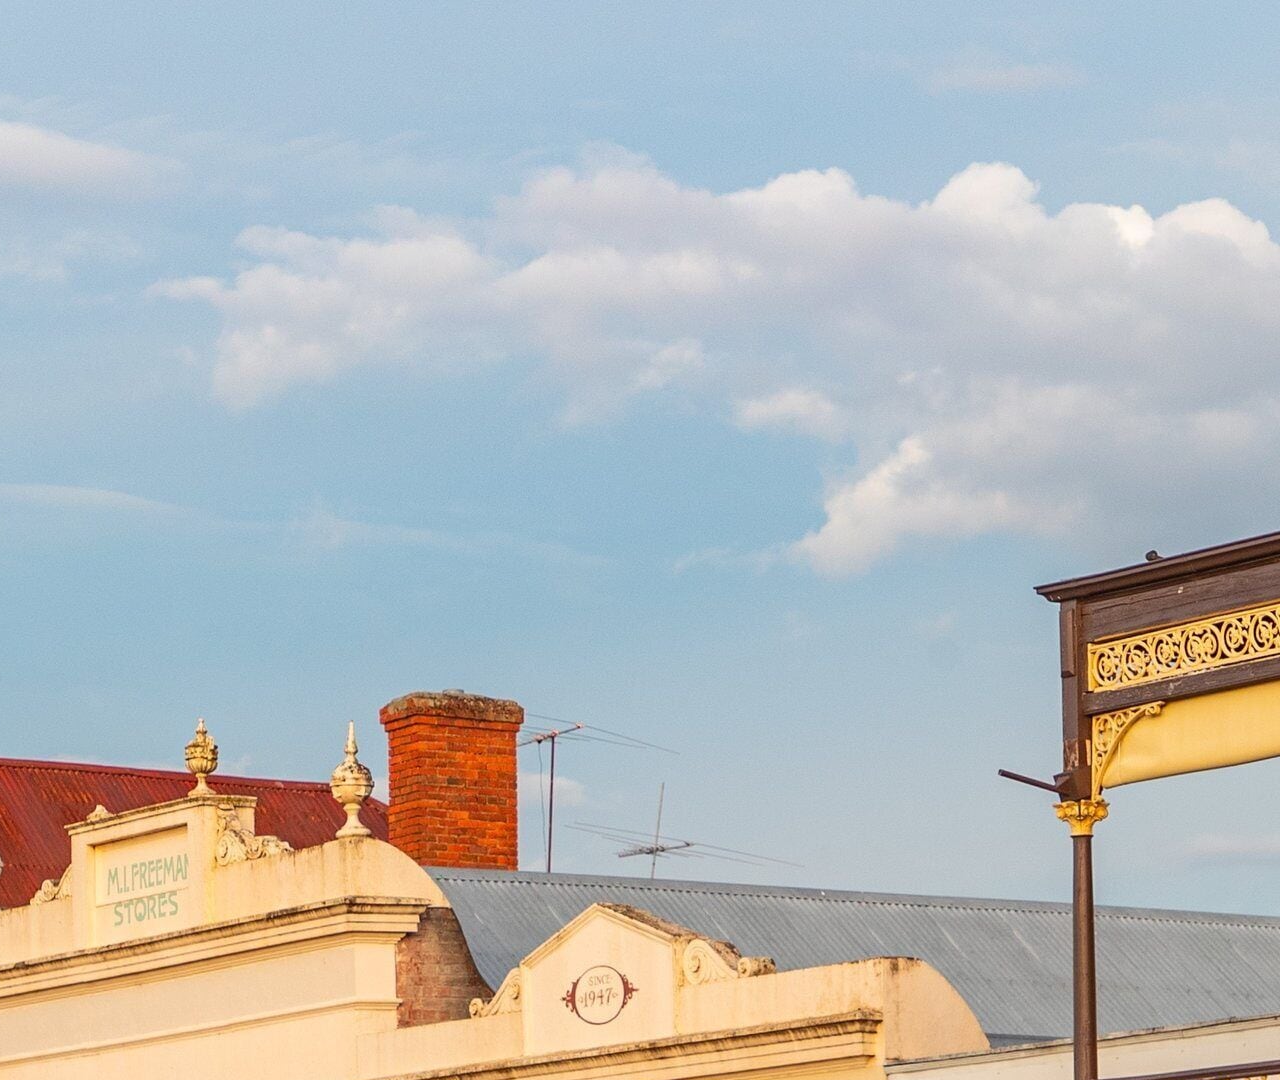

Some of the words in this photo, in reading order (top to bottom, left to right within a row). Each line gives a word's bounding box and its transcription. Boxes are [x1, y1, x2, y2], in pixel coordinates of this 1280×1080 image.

[113, 890, 179, 926] STORES
[587, 974, 612, 987] SINCE
[584, 987, 613, 1008] 1947
